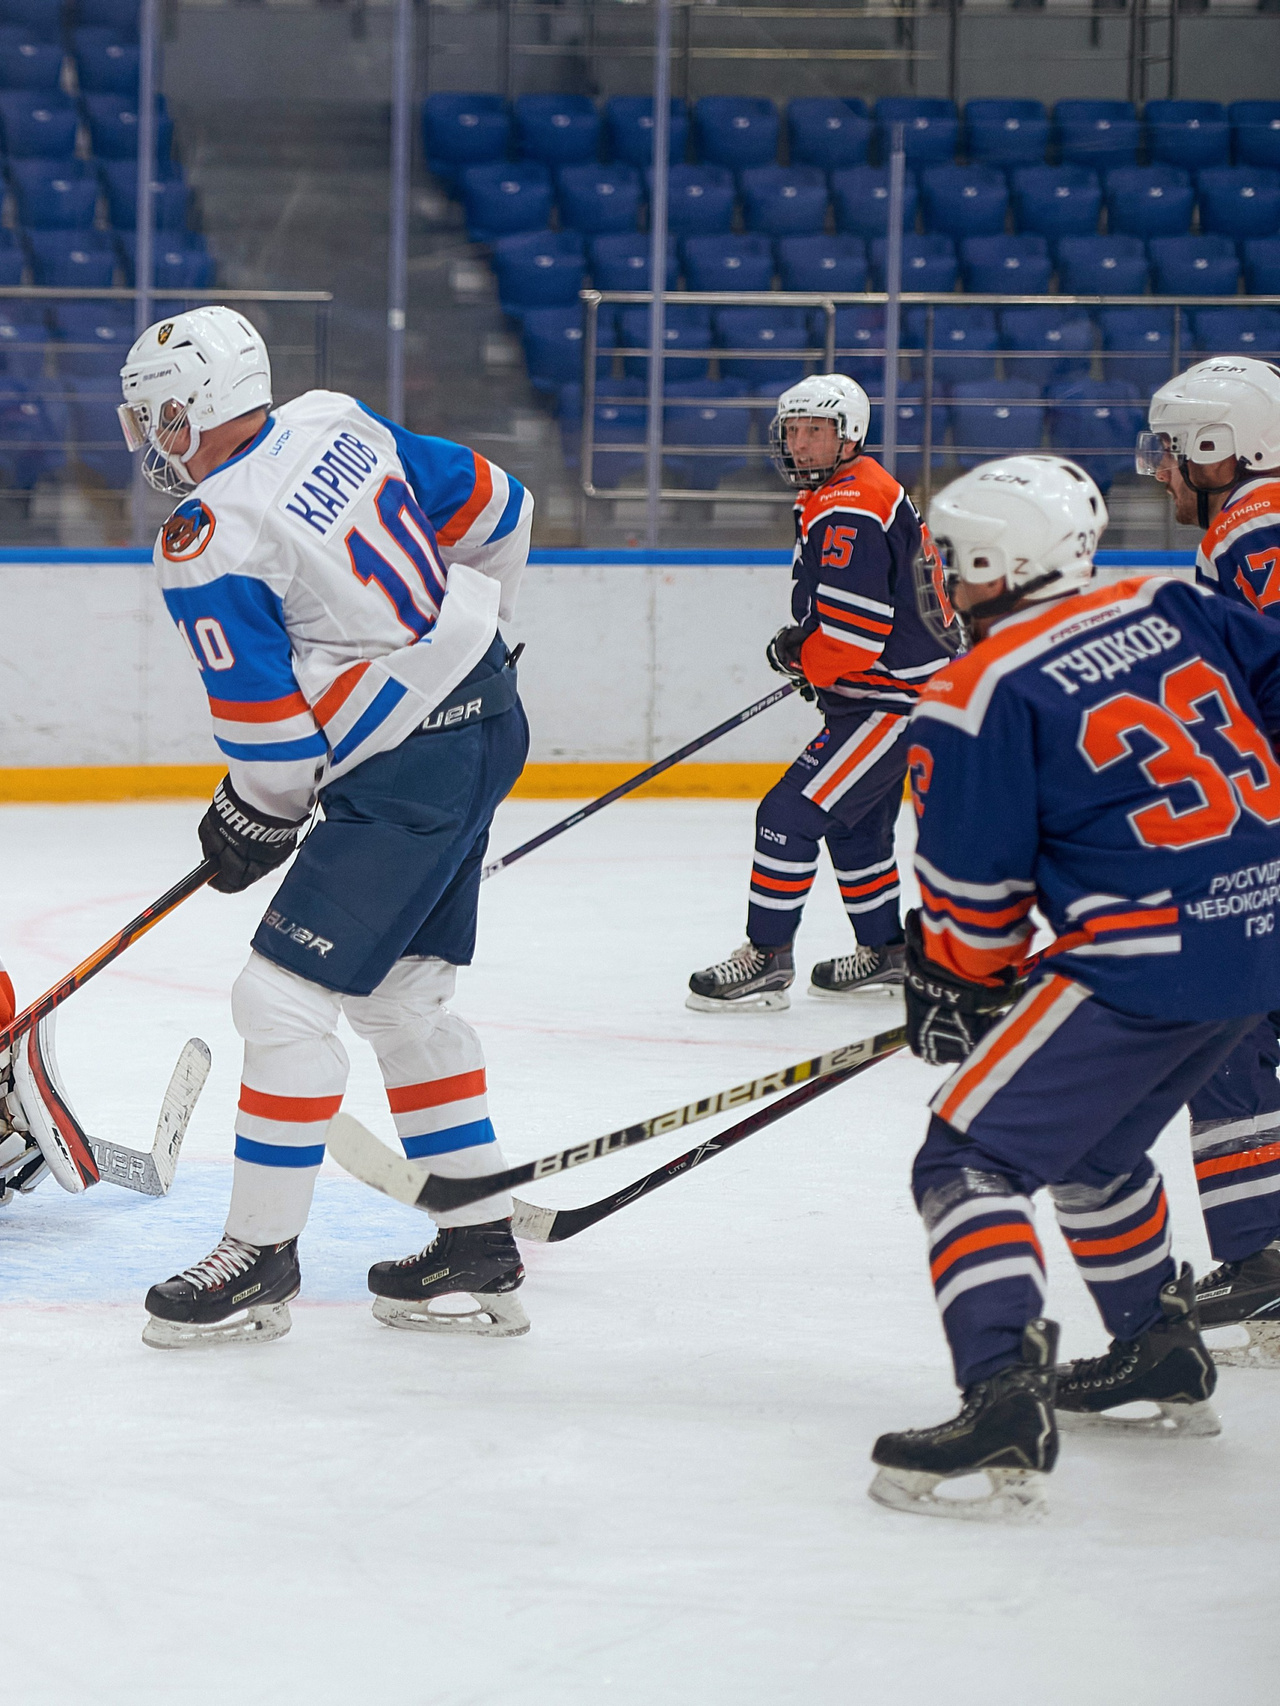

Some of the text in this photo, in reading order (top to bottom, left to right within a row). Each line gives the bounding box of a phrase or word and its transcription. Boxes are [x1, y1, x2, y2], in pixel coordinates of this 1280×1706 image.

[285, 432, 379, 536] КАРПОВ
[979, 473, 1031, 486] CCM
[1215, 500, 1271, 536] РусГидро
[344, 474, 449, 646] 10
[1039, 614, 1182, 695] ГУДКОВ
[422, 697, 482, 730] UER
[1076, 655, 1280, 851] 33
[1184, 884, 1280, 920] ЧЕБОКСАР
[1245, 912, 1275, 937] ГЭС
[93, 1143, 146, 1185] UER
